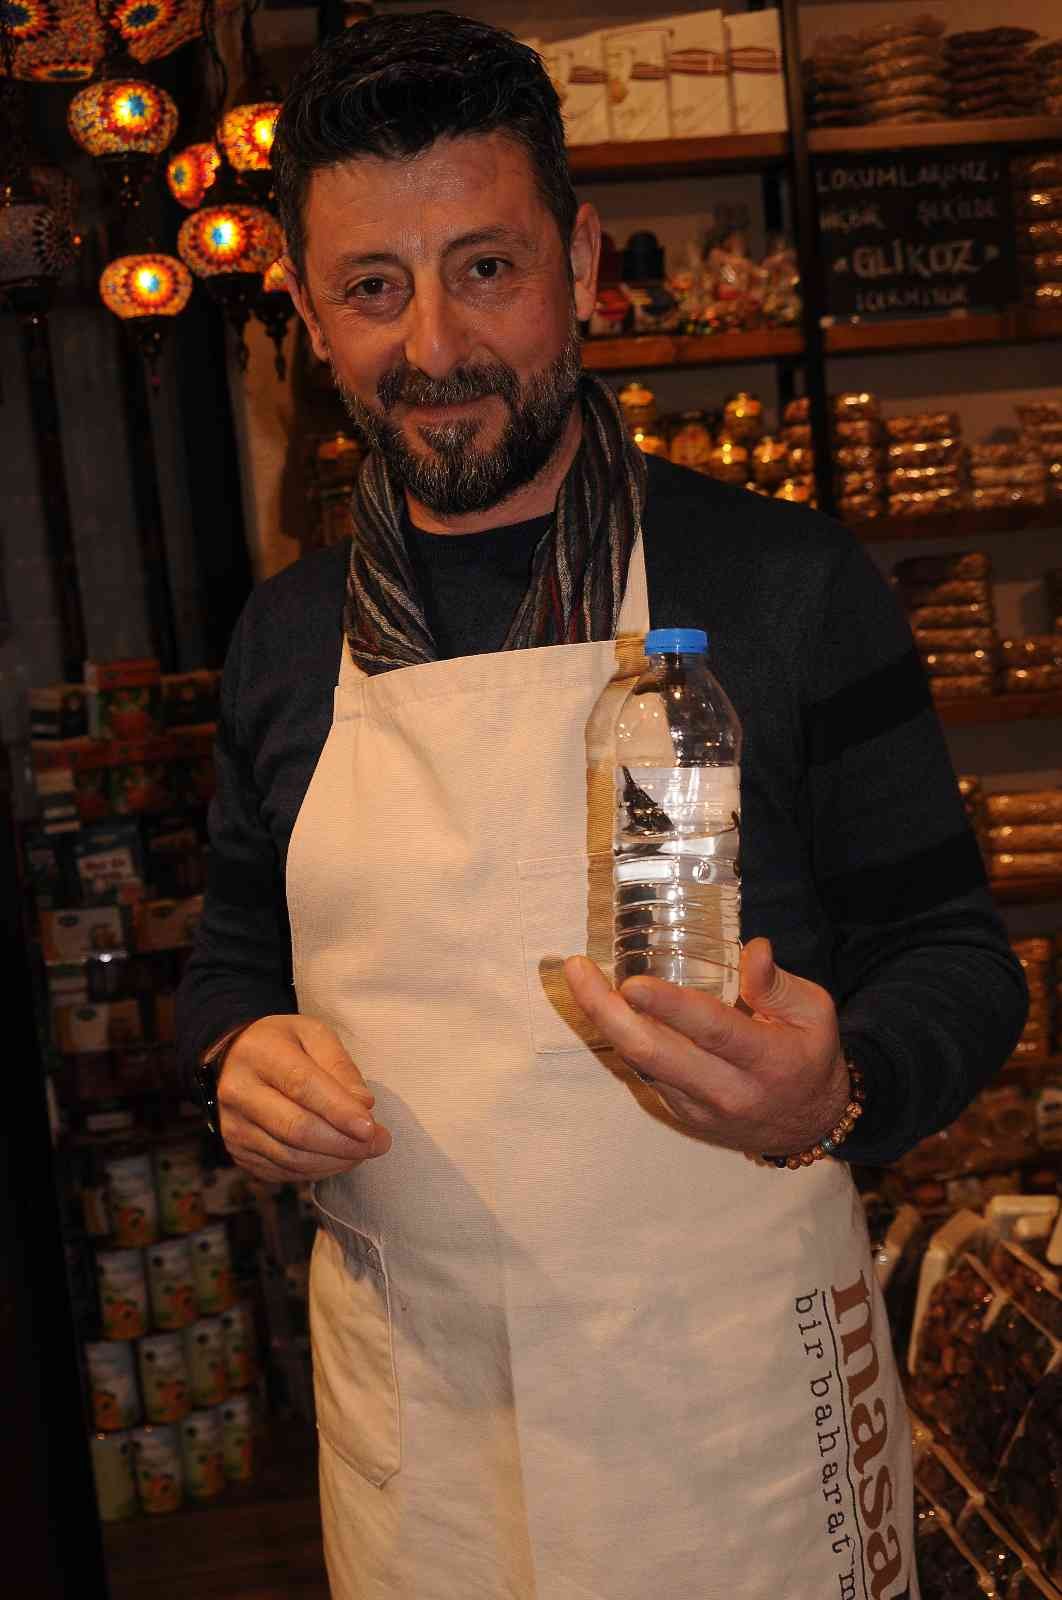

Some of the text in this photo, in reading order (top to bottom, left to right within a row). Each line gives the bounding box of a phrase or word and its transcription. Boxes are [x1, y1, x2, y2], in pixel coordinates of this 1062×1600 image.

[795, 1288, 824, 1359] bir
[810, 1370, 851, 1554] baharat
[831, 1270, 909, 1600] masa
